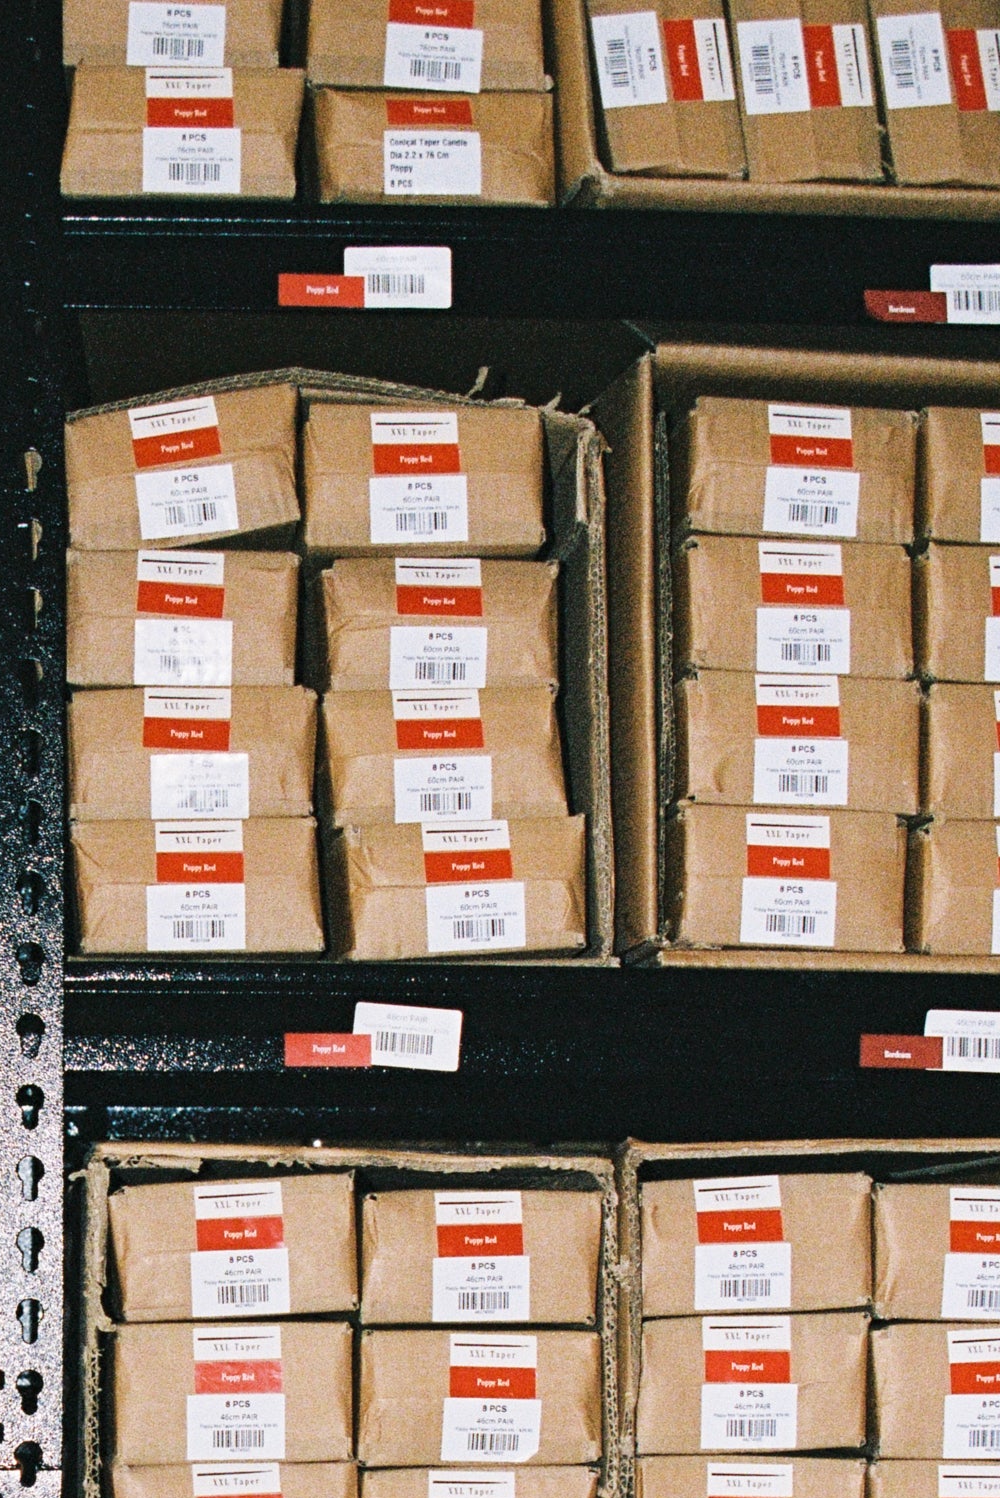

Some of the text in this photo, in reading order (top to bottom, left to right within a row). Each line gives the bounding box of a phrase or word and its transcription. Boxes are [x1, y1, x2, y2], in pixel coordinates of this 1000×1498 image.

[174, 109, 208, 118] Poppy Red
[391, 138, 468, 147] Conical Taper Candle
[391, 151, 403, 159] Dia
[426, 151, 435, 159] 76
[436, 151, 449, 159] Cm
[391, 164, 413, 173] Poppy
[397, 179, 412, 188] PCS
[306, 285, 339, 295] Poppy Red
[196, 836, 222, 845] Taper
[183, 863, 217, 873] Poppy Red
[192, 890, 211, 898] PCS
[312, 1044, 346, 1054] Poppy Red
[235, 1199, 261, 1208] Taper
[223, 1229, 257, 1240] Poppy Red
[236, 1254, 255, 1263] PCS
